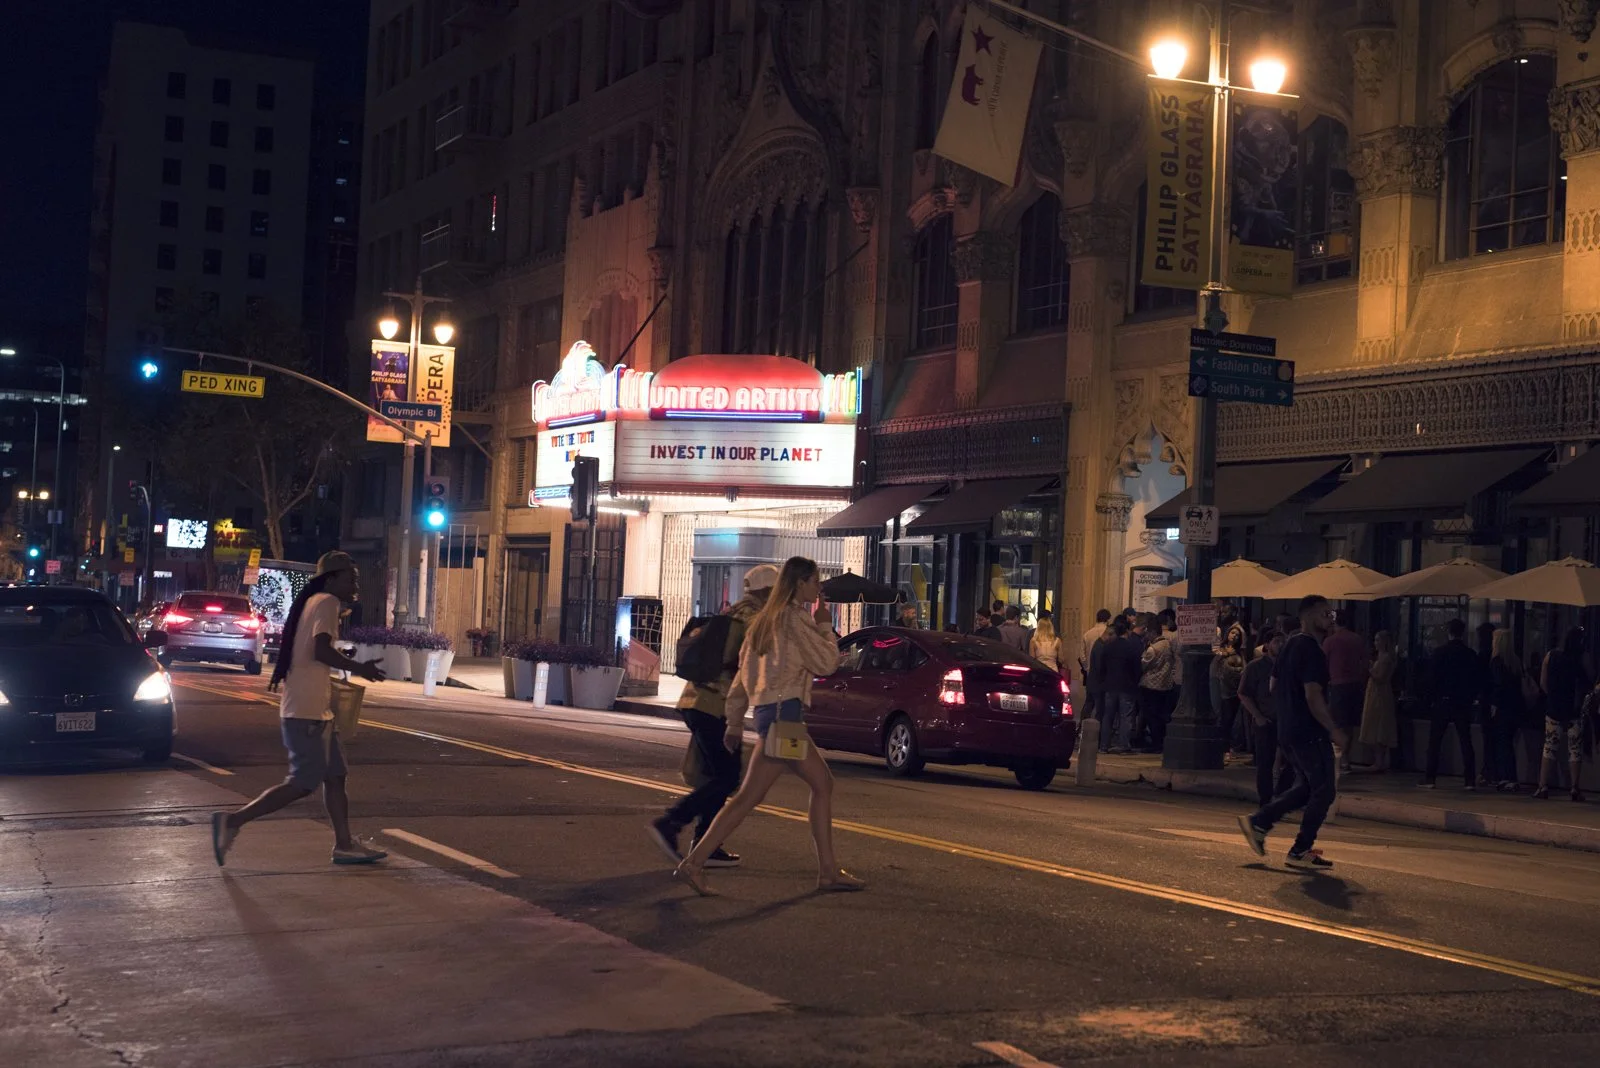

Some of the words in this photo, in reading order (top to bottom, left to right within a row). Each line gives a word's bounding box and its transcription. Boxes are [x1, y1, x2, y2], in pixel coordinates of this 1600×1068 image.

[1160, 94, 1180, 177] GLASS
[1181, 100, 1205, 273] SATYAGRAHA
[1155, 184, 1178, 271] PHILIP
[1193, 335, 1228, 347] HISTORIC
[1229, 339, 1273, 353] DOWNTOWN
[389, 371, 407, 379] GLASS
[1211, 356, 1249, 373] Fashion
[1252, 362, 1273, 376] Dist
[189, 375, 218, 389] PED
[224, 378, 257, 393] XING
[1211, 380, 1240, 396] South
[1243, 384, 1266, 398] Park
[650, 386, 730, 410] UNITED
[735, 387, 822, 411] ARTISTS
[388, 406, 424, 417] Olympic
[650, 444, 706, 460] INVEST
[711, 445, 726, 460] IN
[729, 447, 756, 460] OUR
[760, 447, 823, 462] PLANET
[1189, 520, 1209, 528] ONLY
[1178, 615, 1191, 626] NO
[1191, 616, 1216, 625] PARKING
